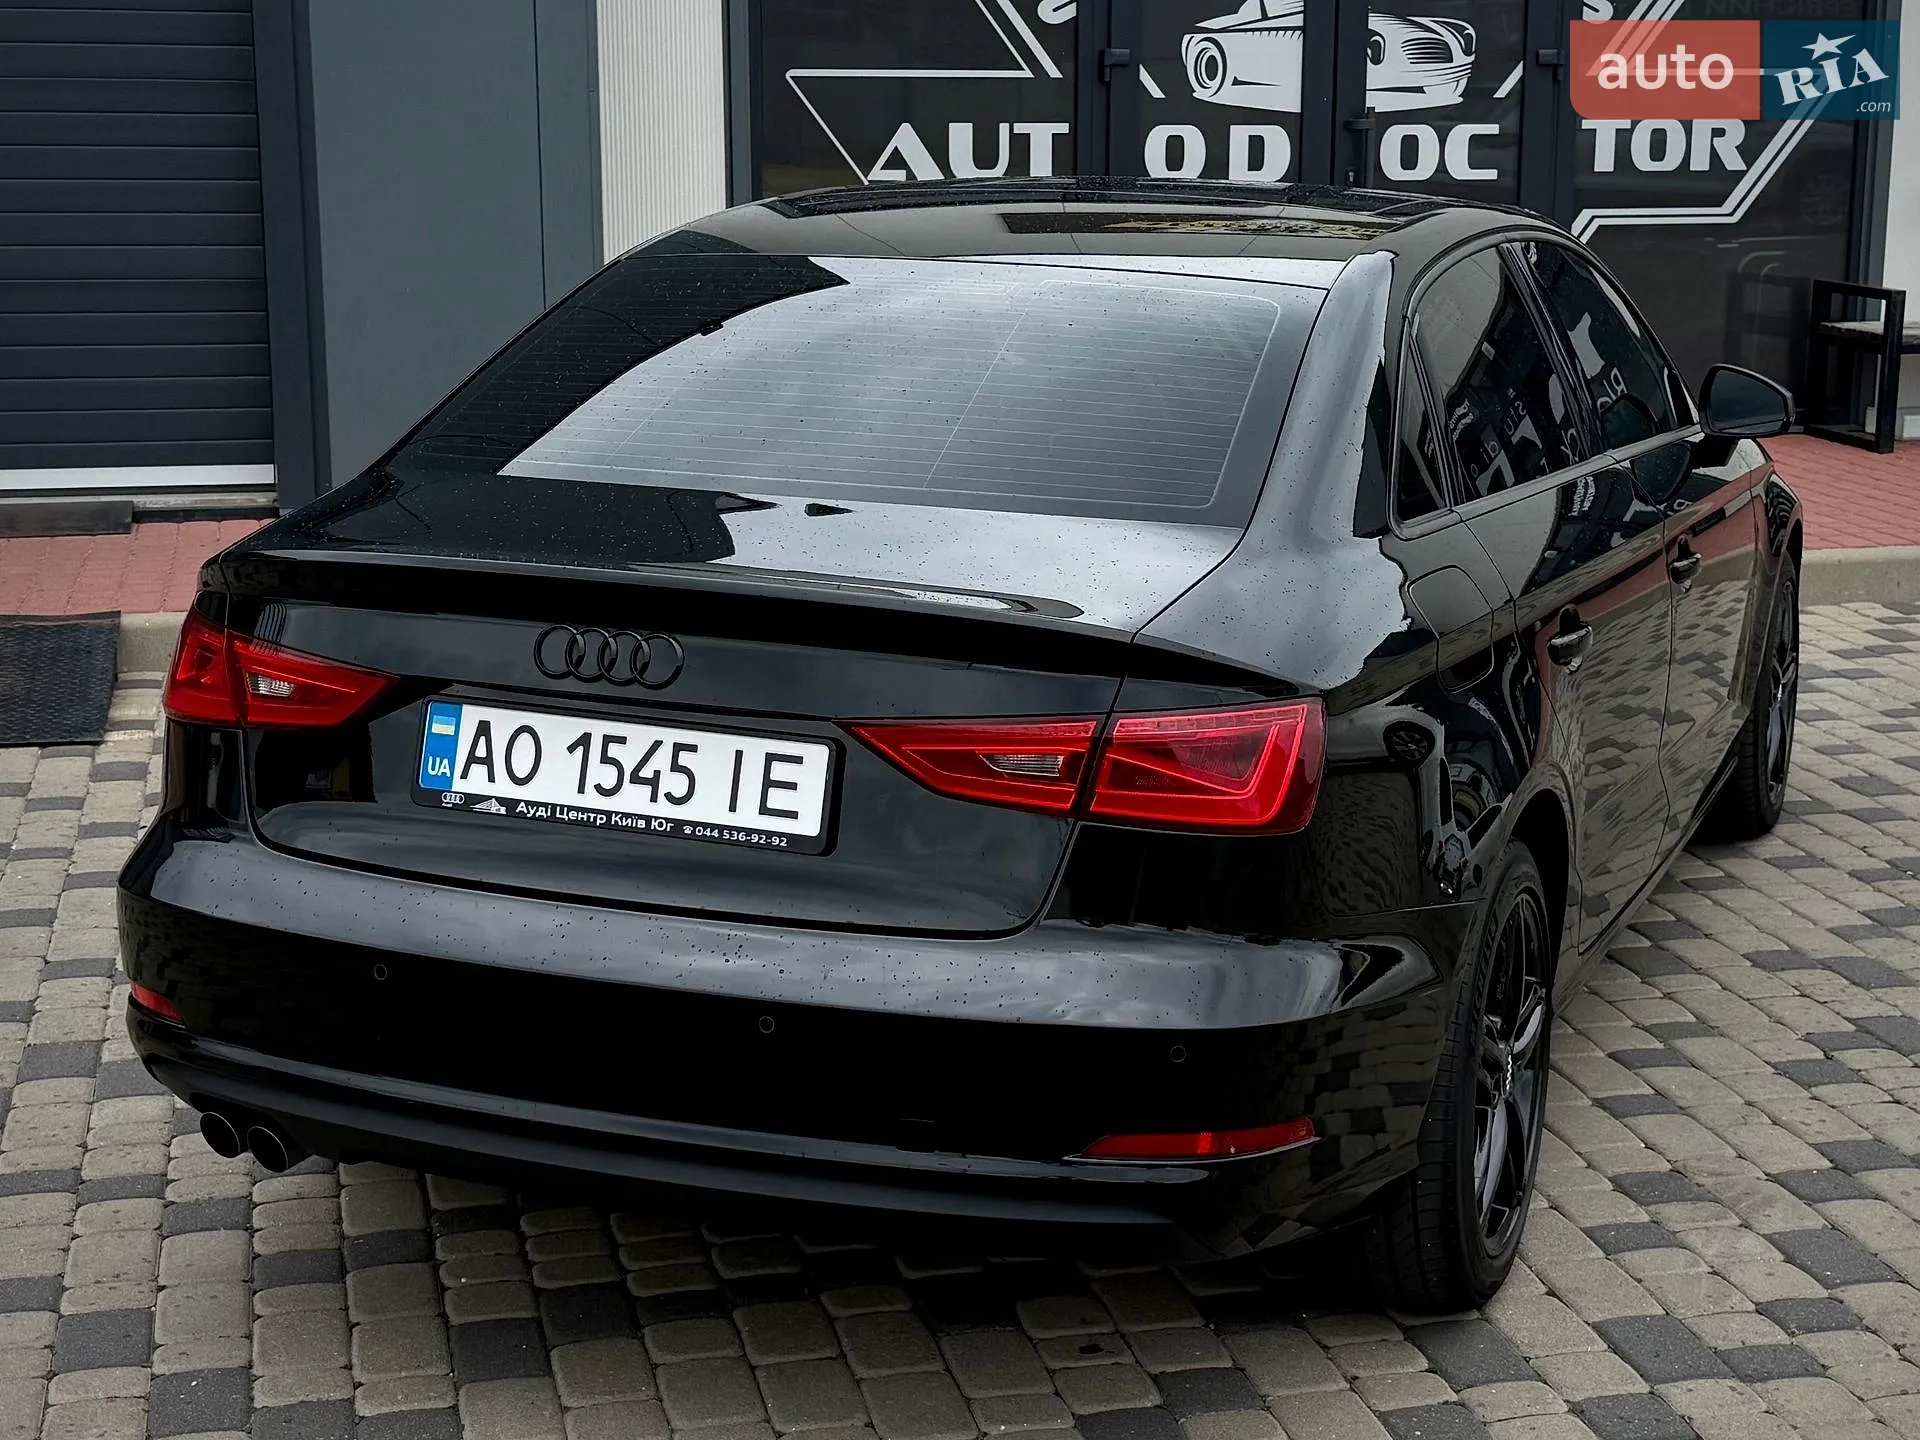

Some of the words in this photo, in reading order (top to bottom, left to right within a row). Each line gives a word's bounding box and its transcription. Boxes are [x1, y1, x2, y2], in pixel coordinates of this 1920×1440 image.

[427, 755, 450, 777] UA
[460, 720, 542, 786] AO
[566, 732, 699, 806] 1545
[728, 749, 804, 820] IE
[515, 801, 550, 818] Ауді
[555, 808, 607, 826] Центр
[611, 813, 646, 829] Київ
[650, 818, 674, 832] Юг
[695, 826, 720, 838] 044
[722, 830, 788, 847] 536-92-92
